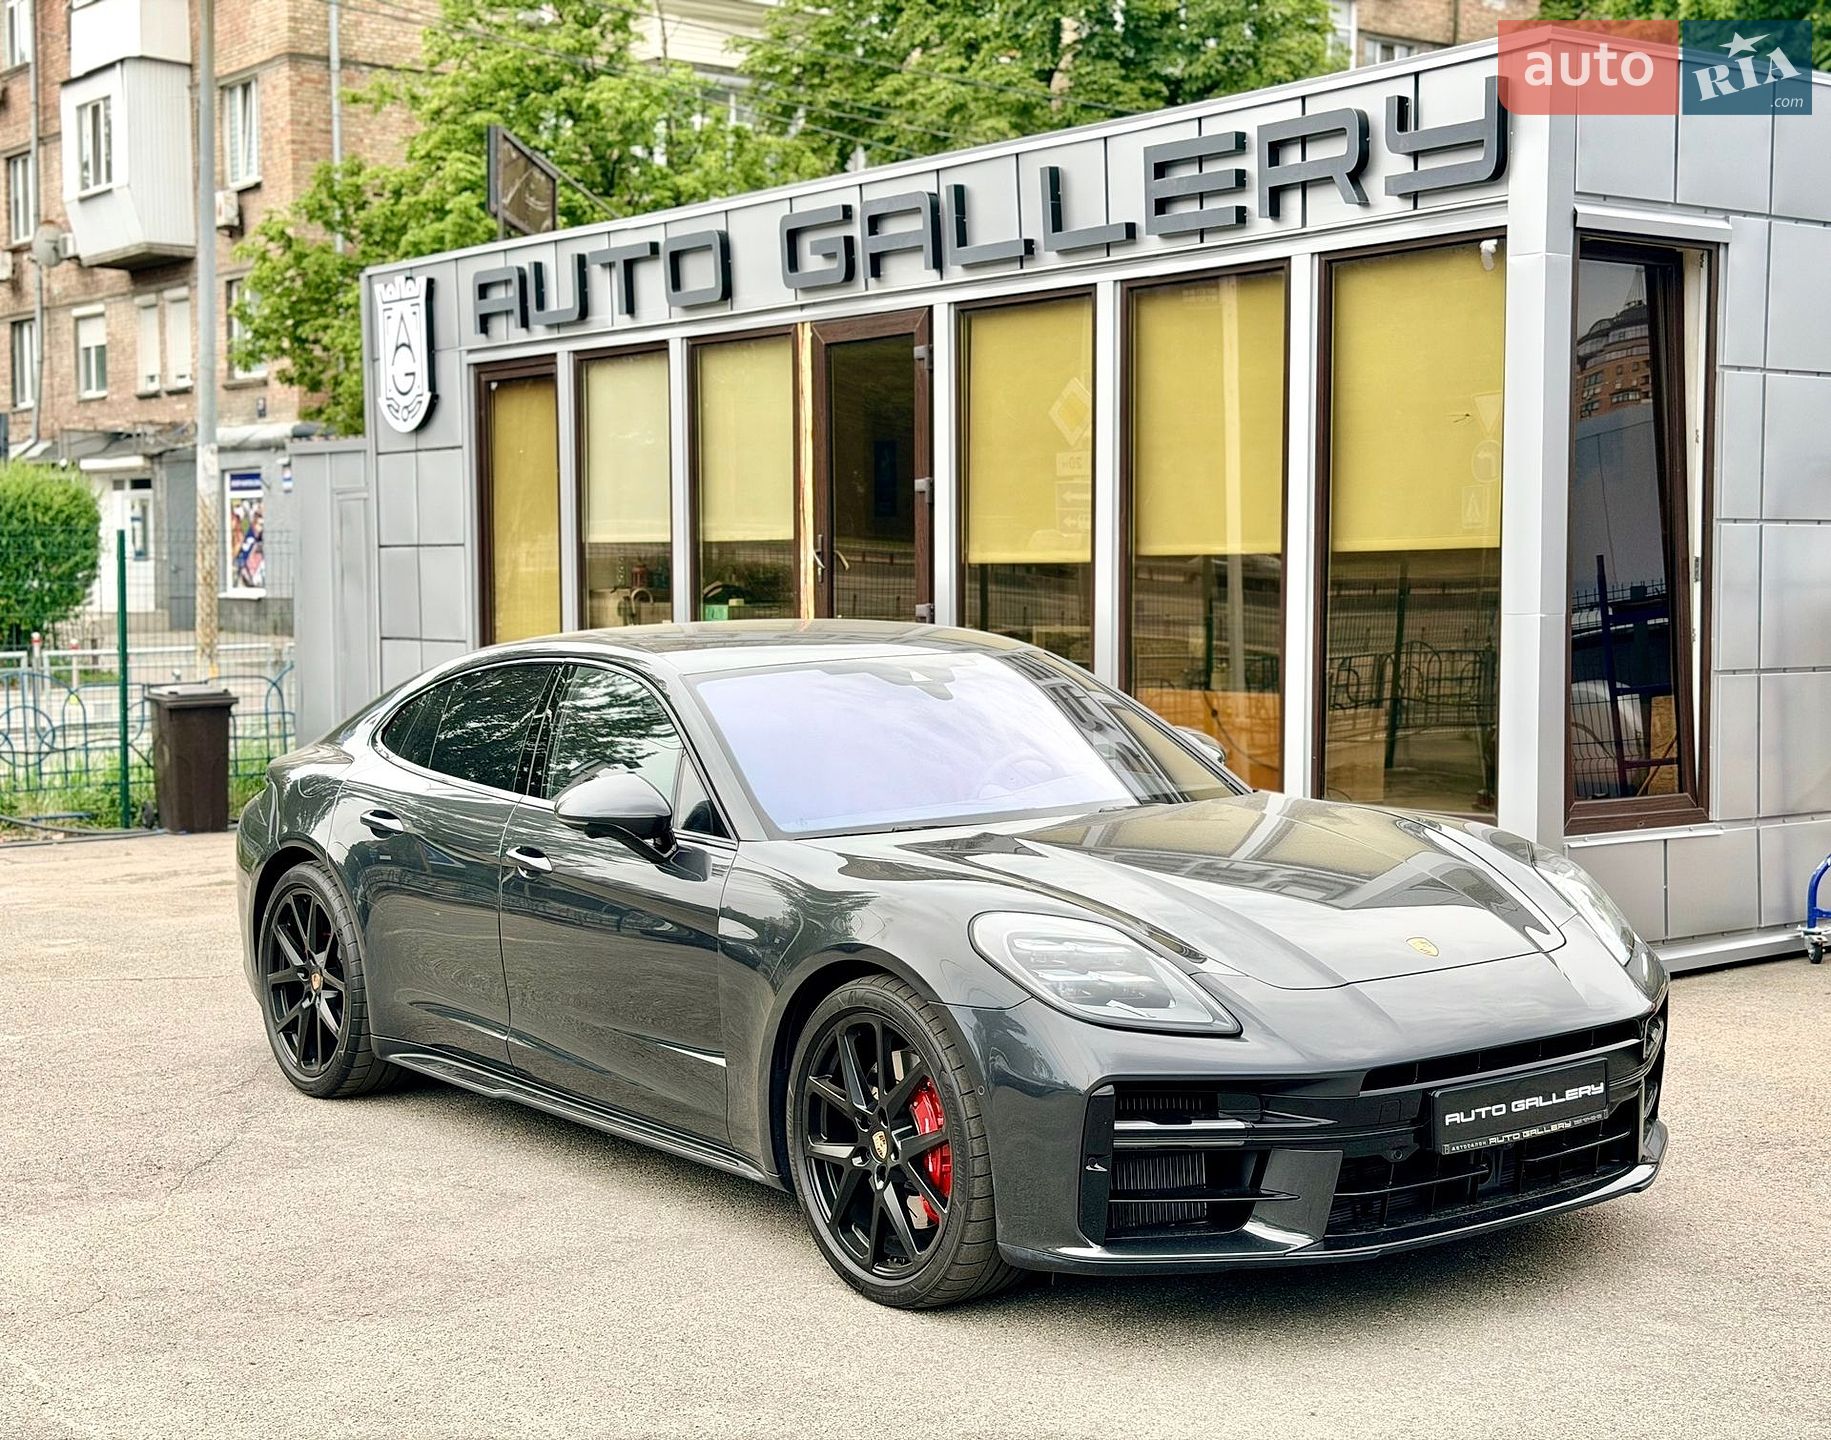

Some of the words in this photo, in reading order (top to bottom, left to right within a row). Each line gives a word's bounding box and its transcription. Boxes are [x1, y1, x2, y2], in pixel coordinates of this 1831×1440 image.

[472, 229, 730, 336] AUTO
[780, 75, 1509, 290] GALLERY
[1444, 1103, 1506, 1126] AUTO
[1511, 1081, 1604, 1112] GALLERY
[1488, 1132, 1520, 1145] AUTO
